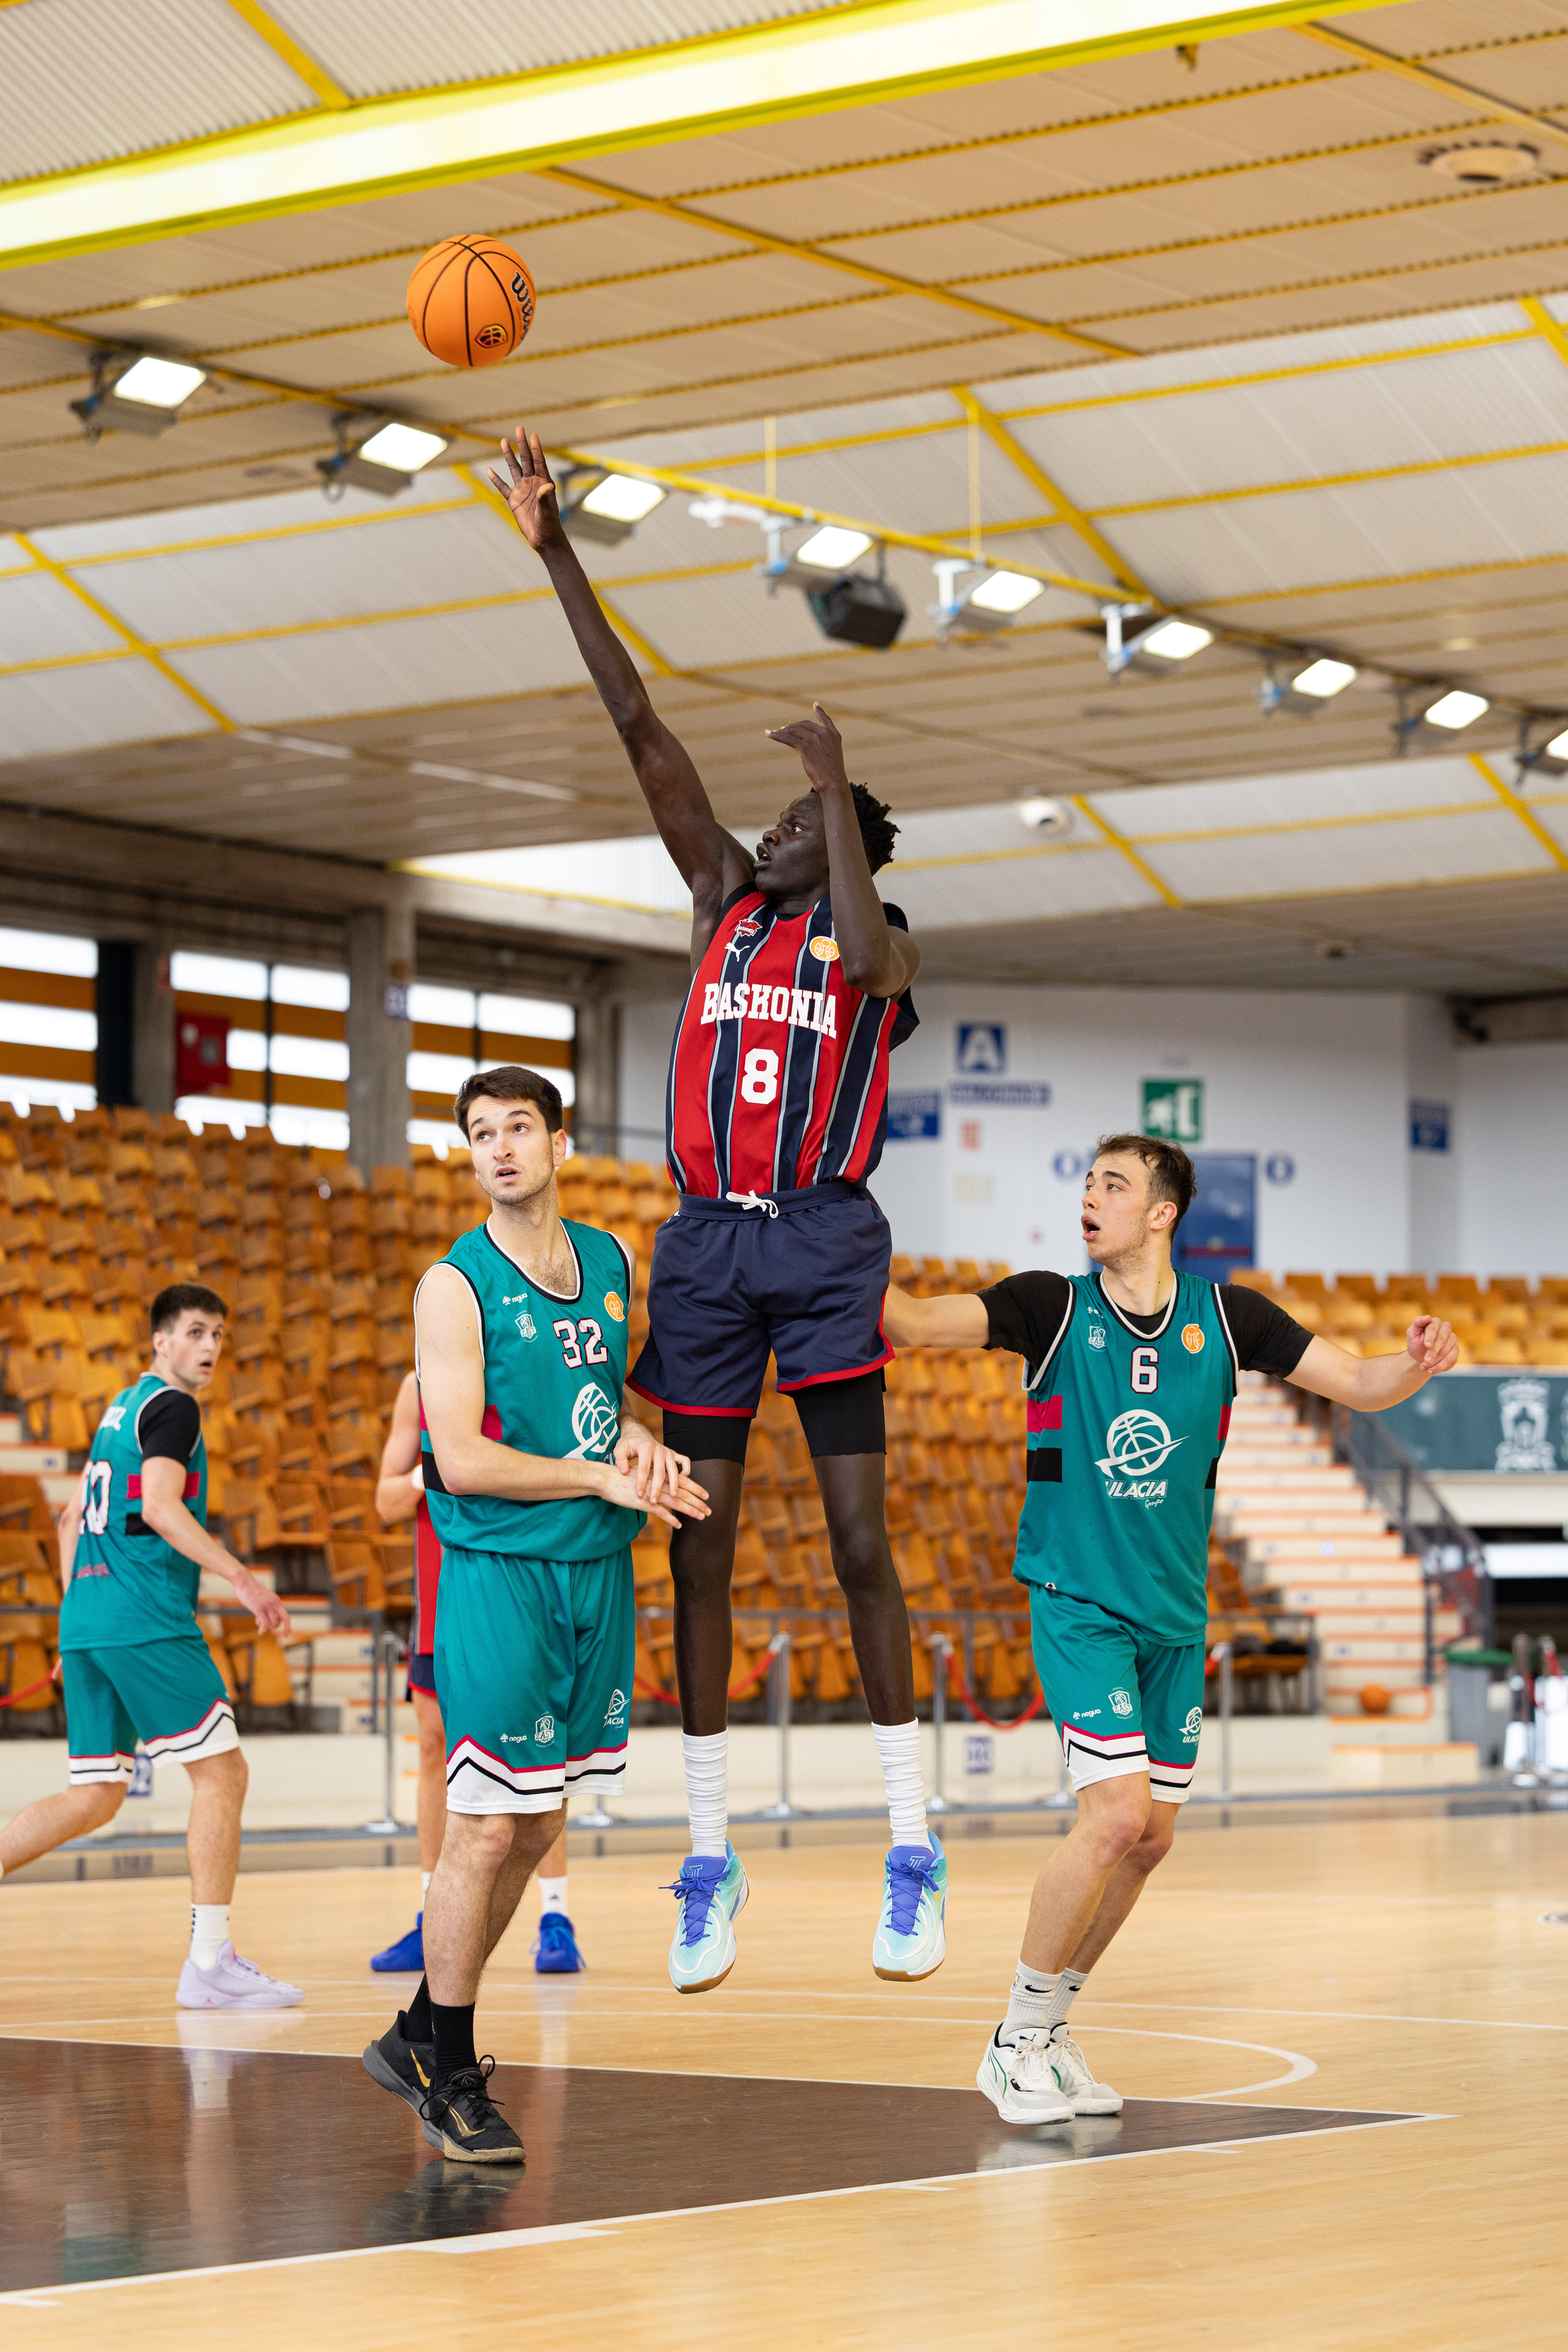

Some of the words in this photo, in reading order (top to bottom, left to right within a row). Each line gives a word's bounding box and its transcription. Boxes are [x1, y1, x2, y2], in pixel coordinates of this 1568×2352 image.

[701, 982, 837, 1039] BASKONIA
[741, 1048, 779, 1105] 8
[512, 1293, 528, 1303] negua
[552, 1318, 608, 1370] 32
[1130, 1346, 1159, 1394] 6
[1081, 1709, 1101, 1717] negua
[1114, 1704, 1131, 1712] ZAST
[509, 1735, 527, 1743] negua
[535, 1730, 553, 1740] ZAST
